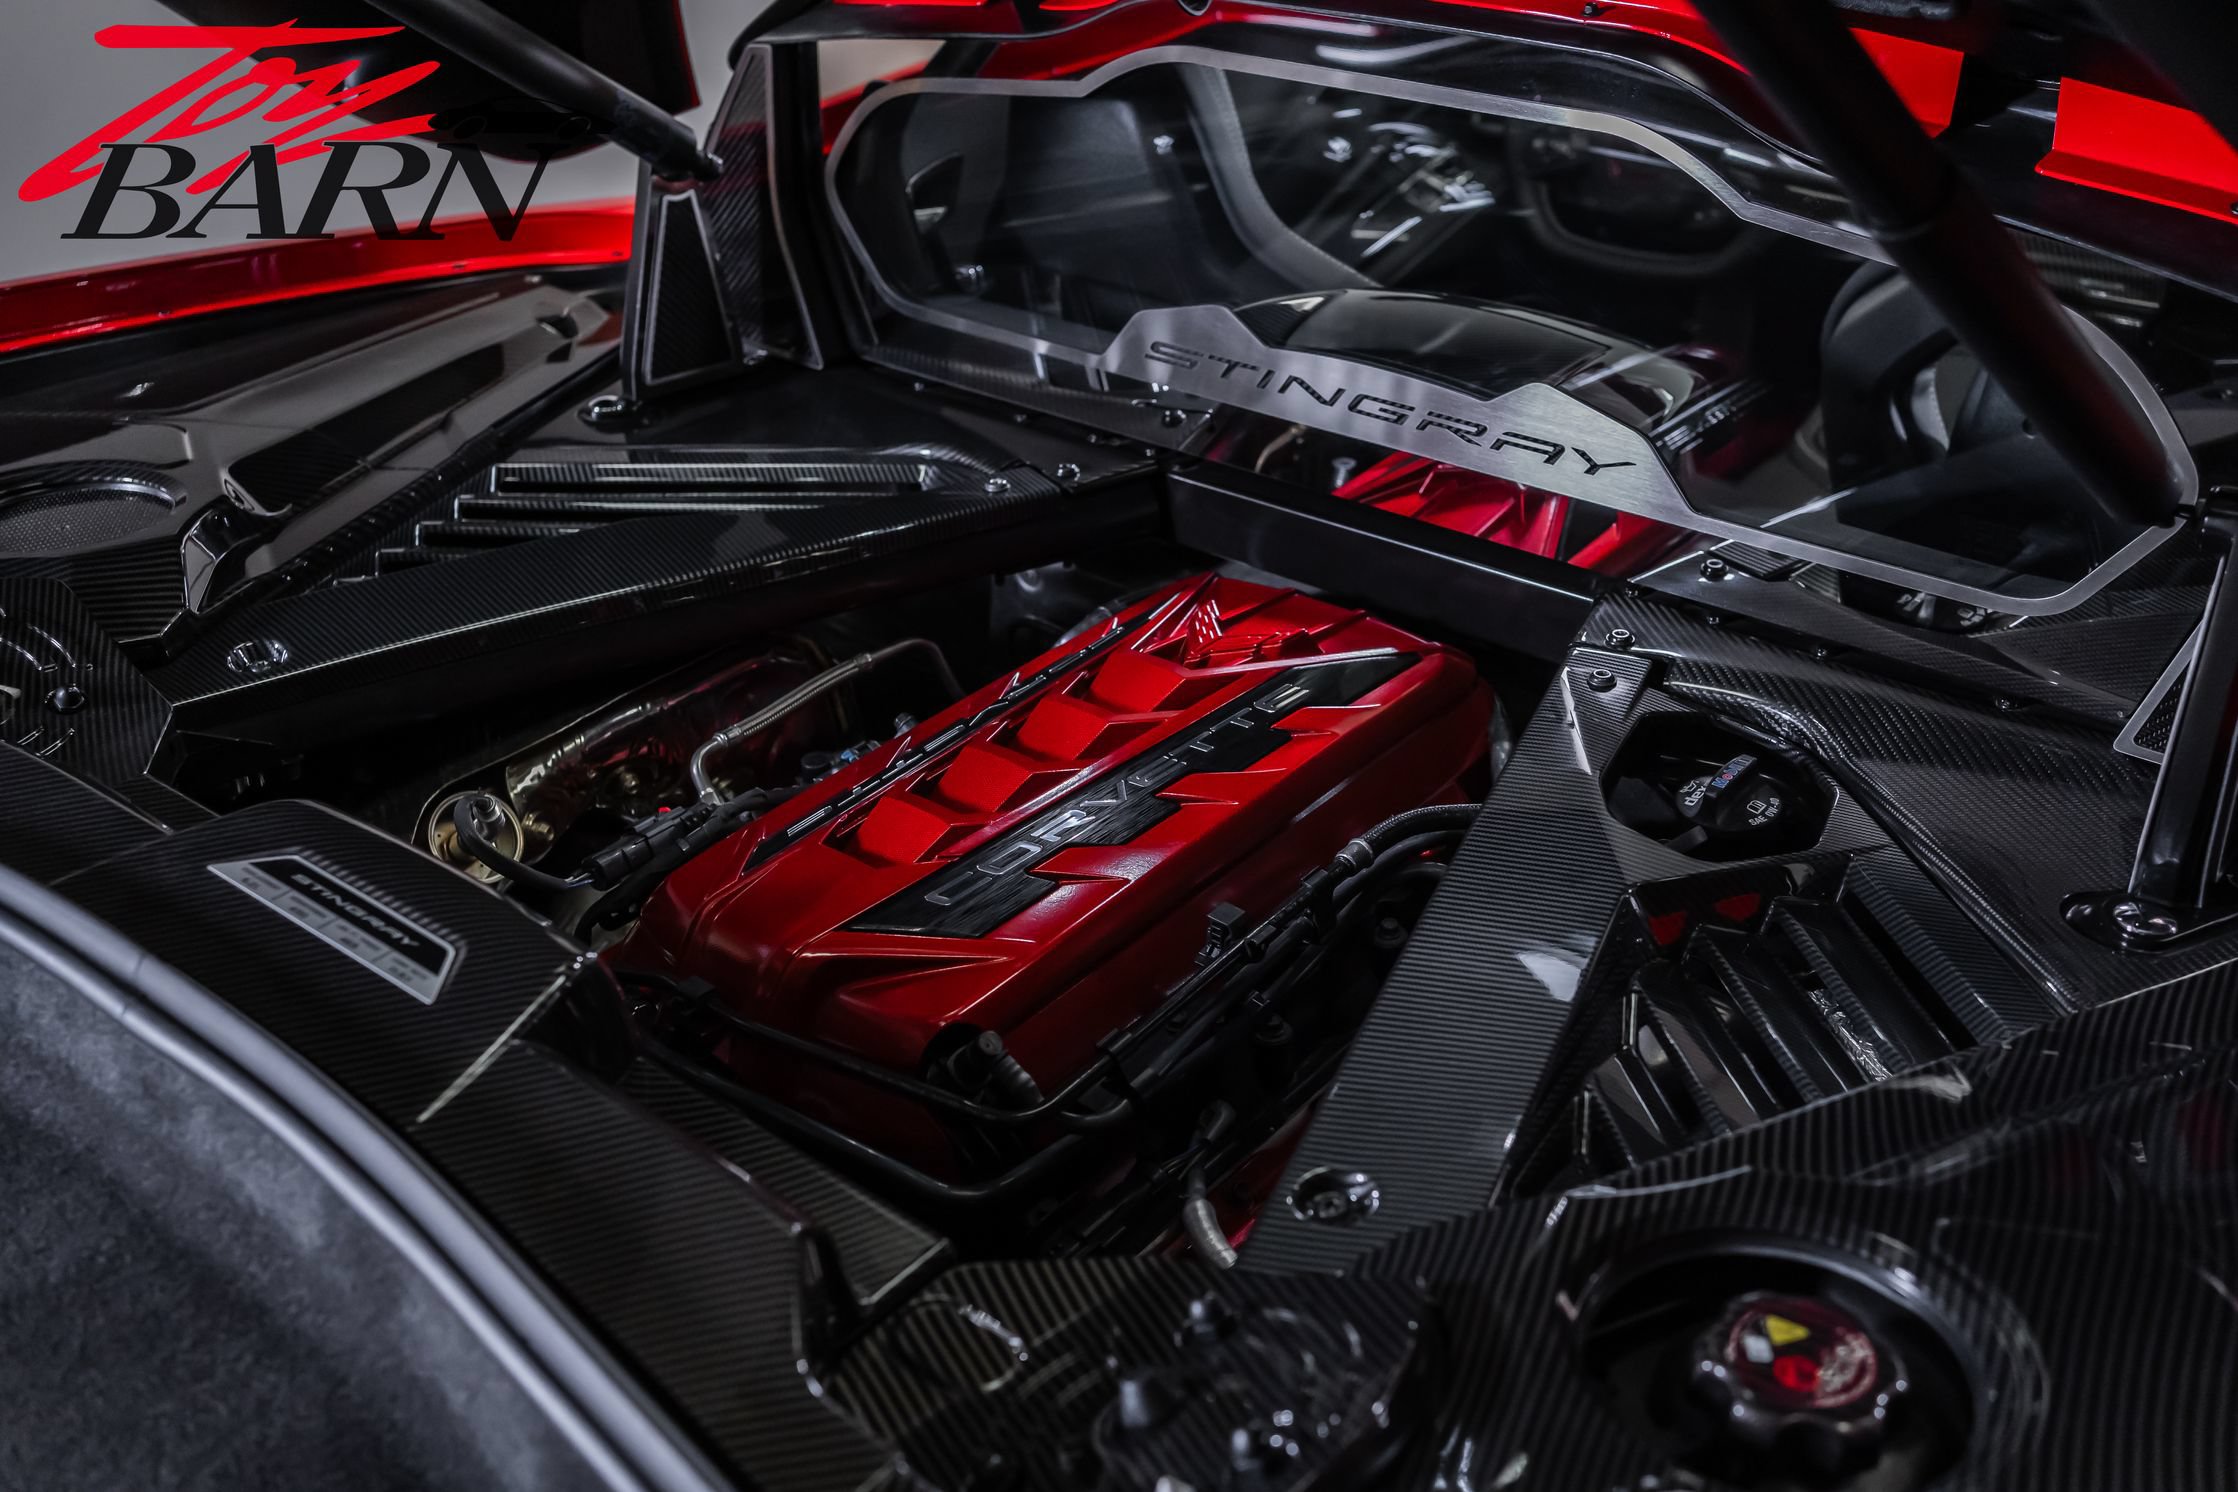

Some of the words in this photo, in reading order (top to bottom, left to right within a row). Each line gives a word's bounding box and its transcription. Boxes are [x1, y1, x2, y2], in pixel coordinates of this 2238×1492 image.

[1145, 341, 1636, 476] STINGRAY
[924, 683, 1310, 906] CORVETTE
[1747, 815, 1767, 825] SAE
[291, 874, 420, 946] STINGRAY
